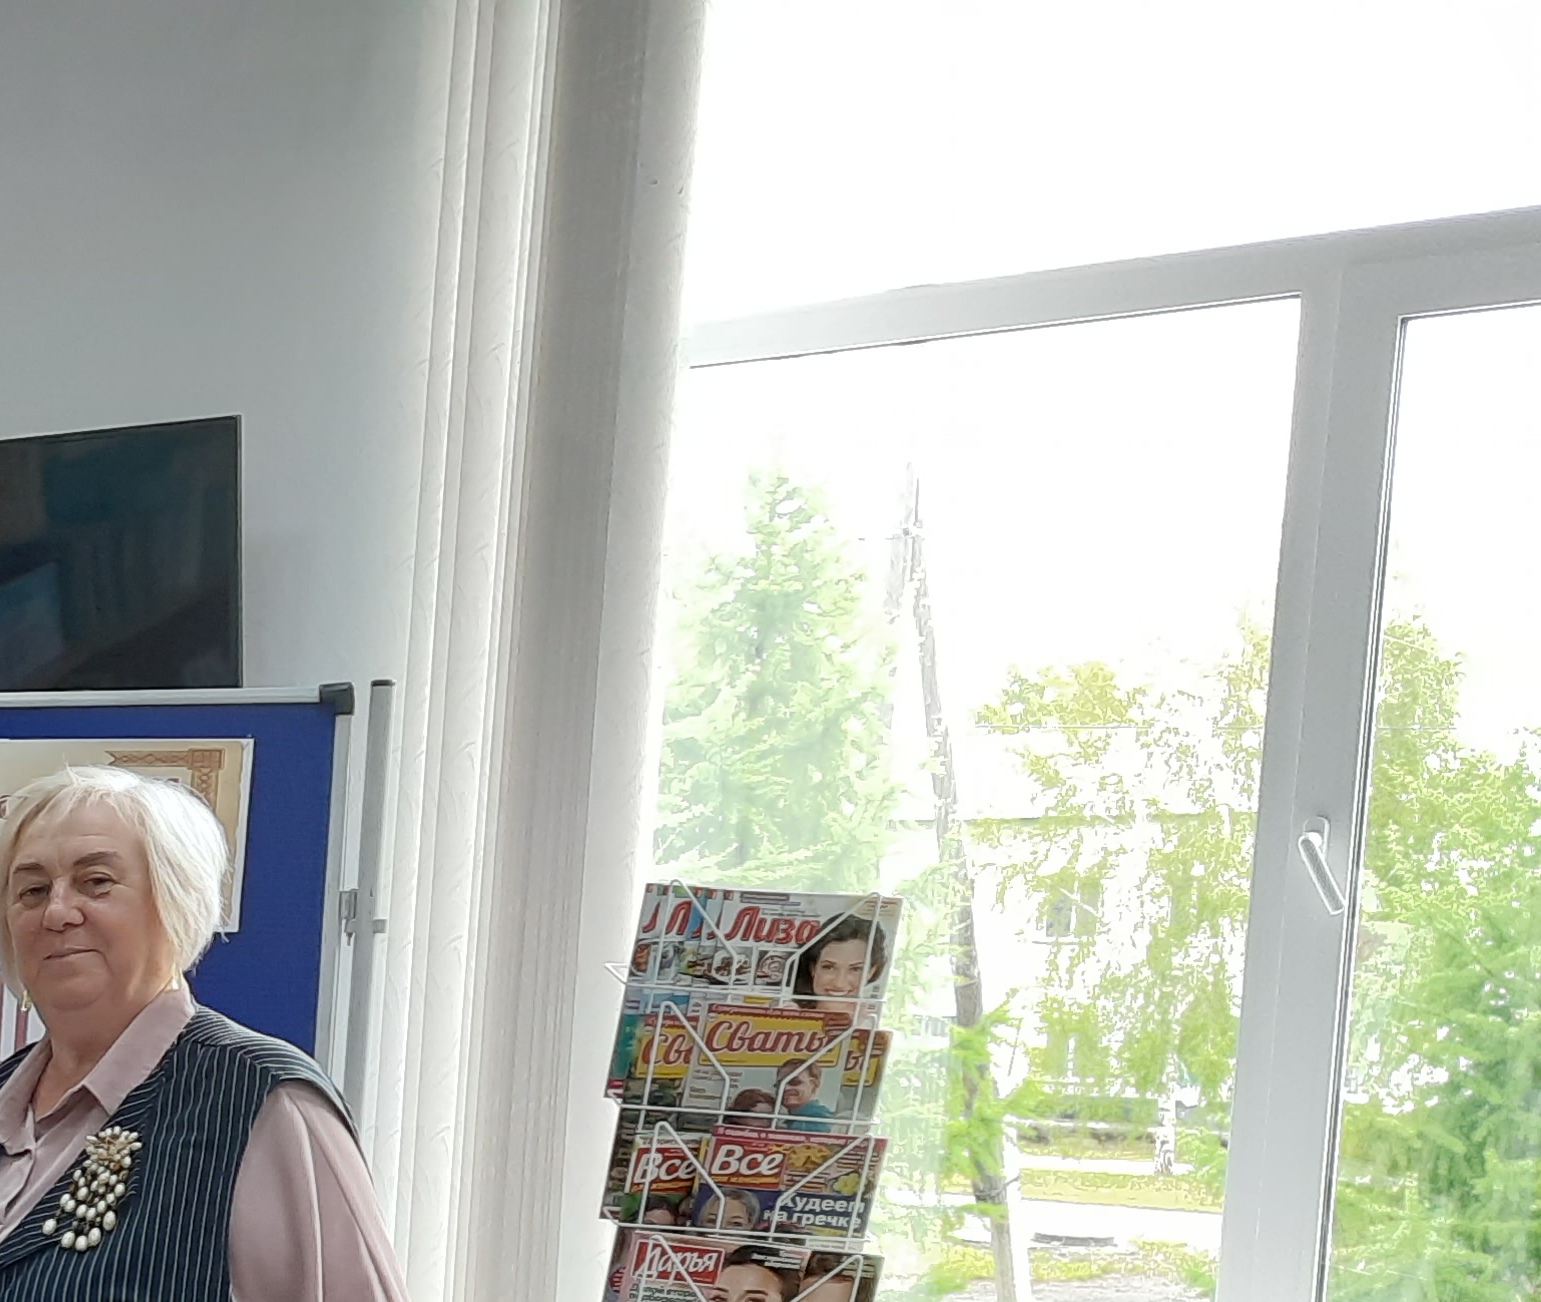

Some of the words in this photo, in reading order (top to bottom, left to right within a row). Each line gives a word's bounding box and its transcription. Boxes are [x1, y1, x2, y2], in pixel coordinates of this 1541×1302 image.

[725, 905, 821, 944] Лиза
[634, 1151, 697, 1184] Все
[710, 1144, 784, 1176] Все
[791, 1211, 862, 1229] гречке
[631, 1243, 719, 1284] Дарья
